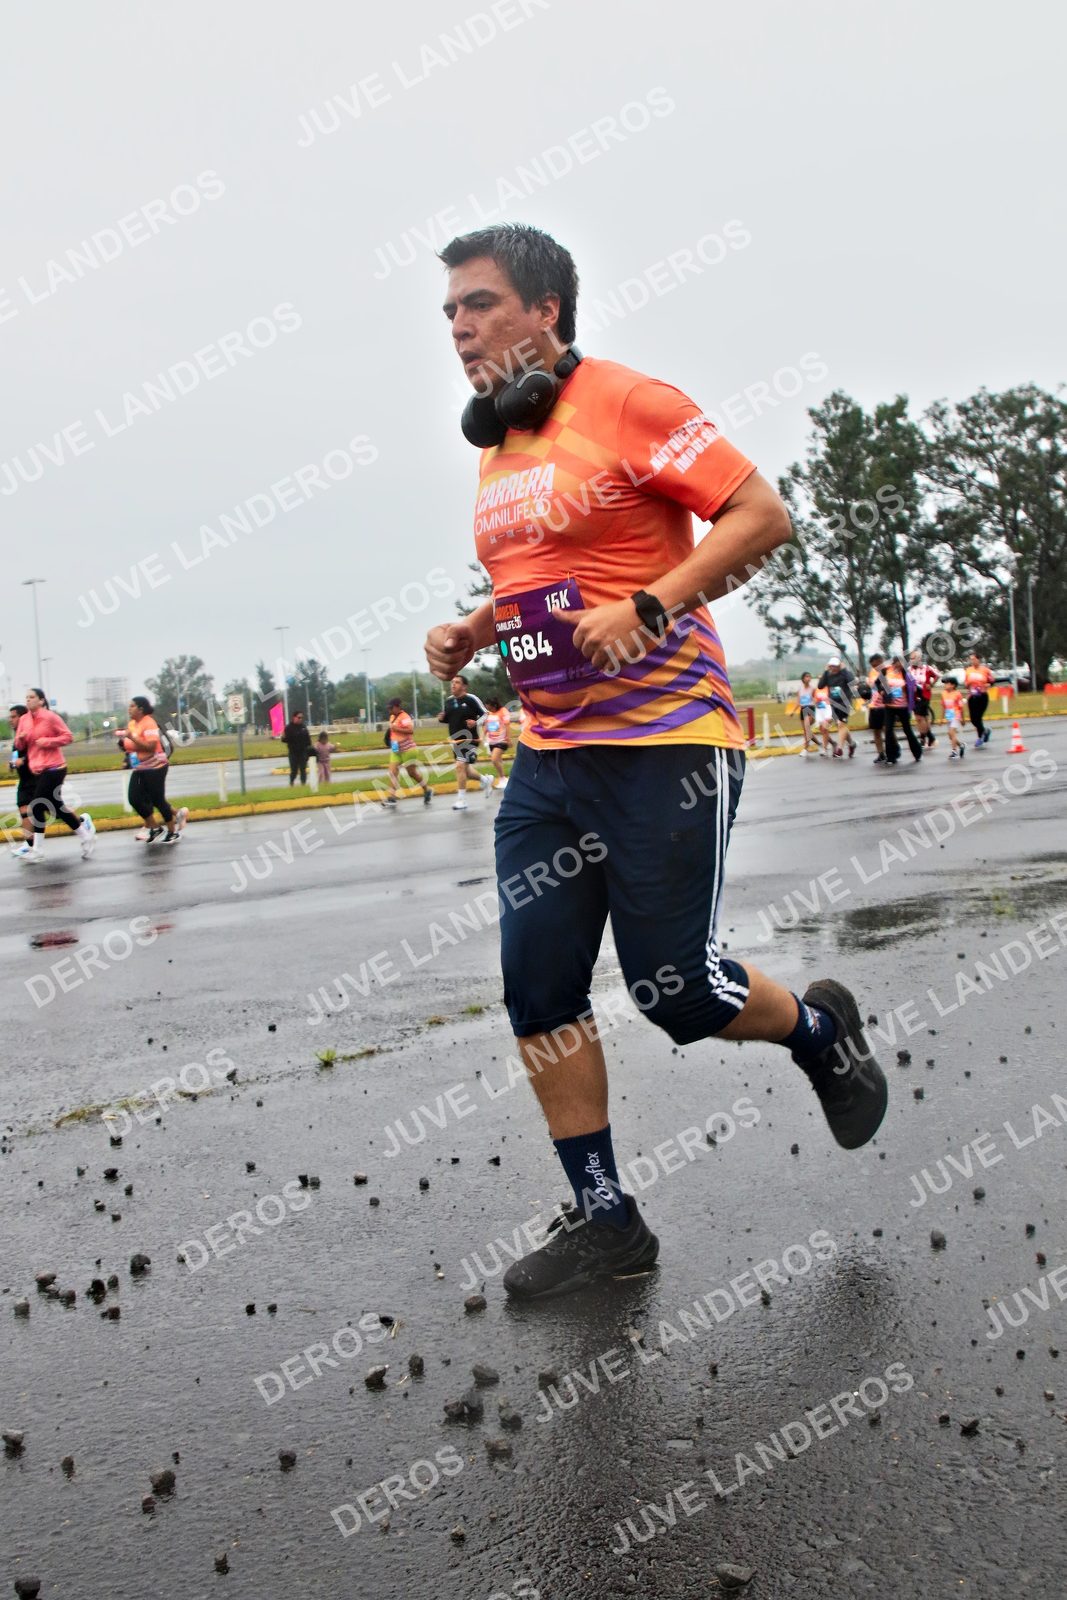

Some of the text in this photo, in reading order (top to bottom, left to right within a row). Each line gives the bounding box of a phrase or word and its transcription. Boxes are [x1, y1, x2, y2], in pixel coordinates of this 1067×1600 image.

[476, 463, 555, 514] CARRERA
[475, 501, 531, 537] OMNILIFE
[545, 589, 571, 613] 15K
[510, 632, 553, 663] 684
